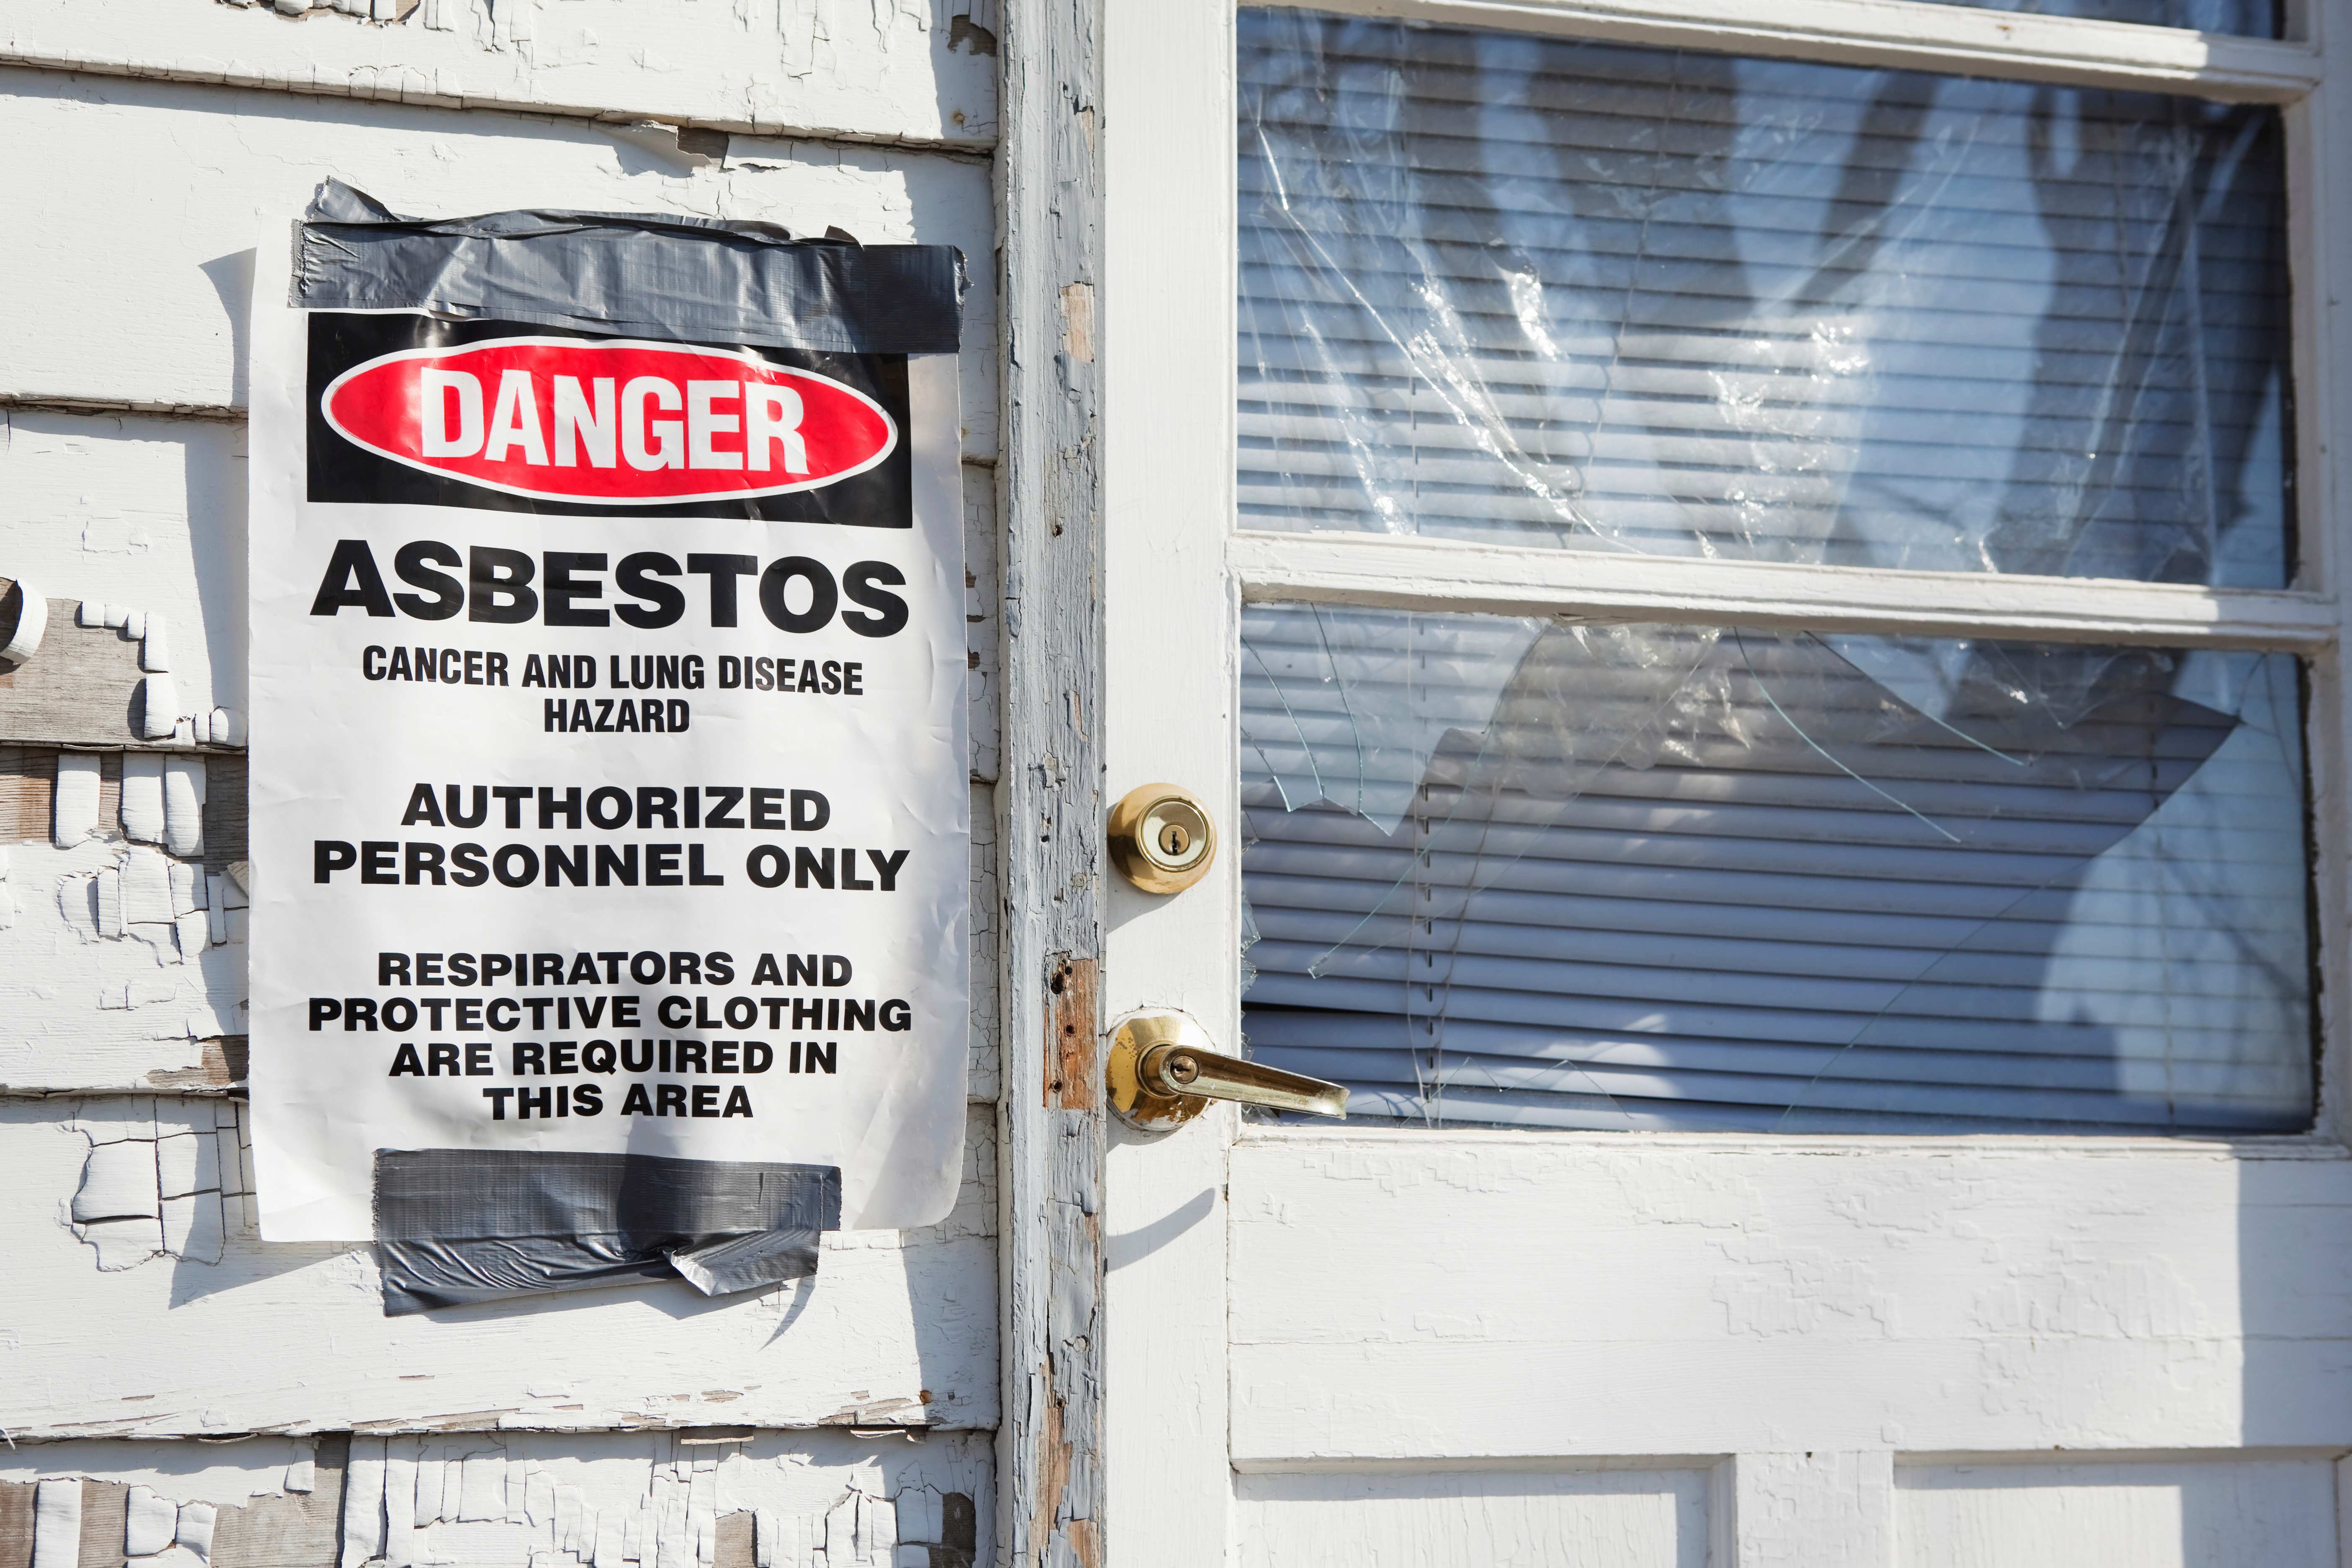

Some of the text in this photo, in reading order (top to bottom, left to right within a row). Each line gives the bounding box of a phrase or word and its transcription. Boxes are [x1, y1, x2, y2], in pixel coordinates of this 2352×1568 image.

[420, 367, 810, 475] DANGER
[310, 540, 908, 637] ASBESTOS
[364, 645, 862, 695] CANCER AND LUNG DISEASE
[545, 699, 689, 732] HAZARD
[401, 784, 830, 831] AUTHORIZED
[315, 841, 910, 891] PERSONNEL ONLY
[379, 951, 852, 986] RESPIRATORS AND
[309, 996, 911, 1032] PROTECTIVE CLOTHING
[389, 1039, 836, 1076] ARE REQUIRED IN
[483, 1083, 753, 1120] THIS AREA
